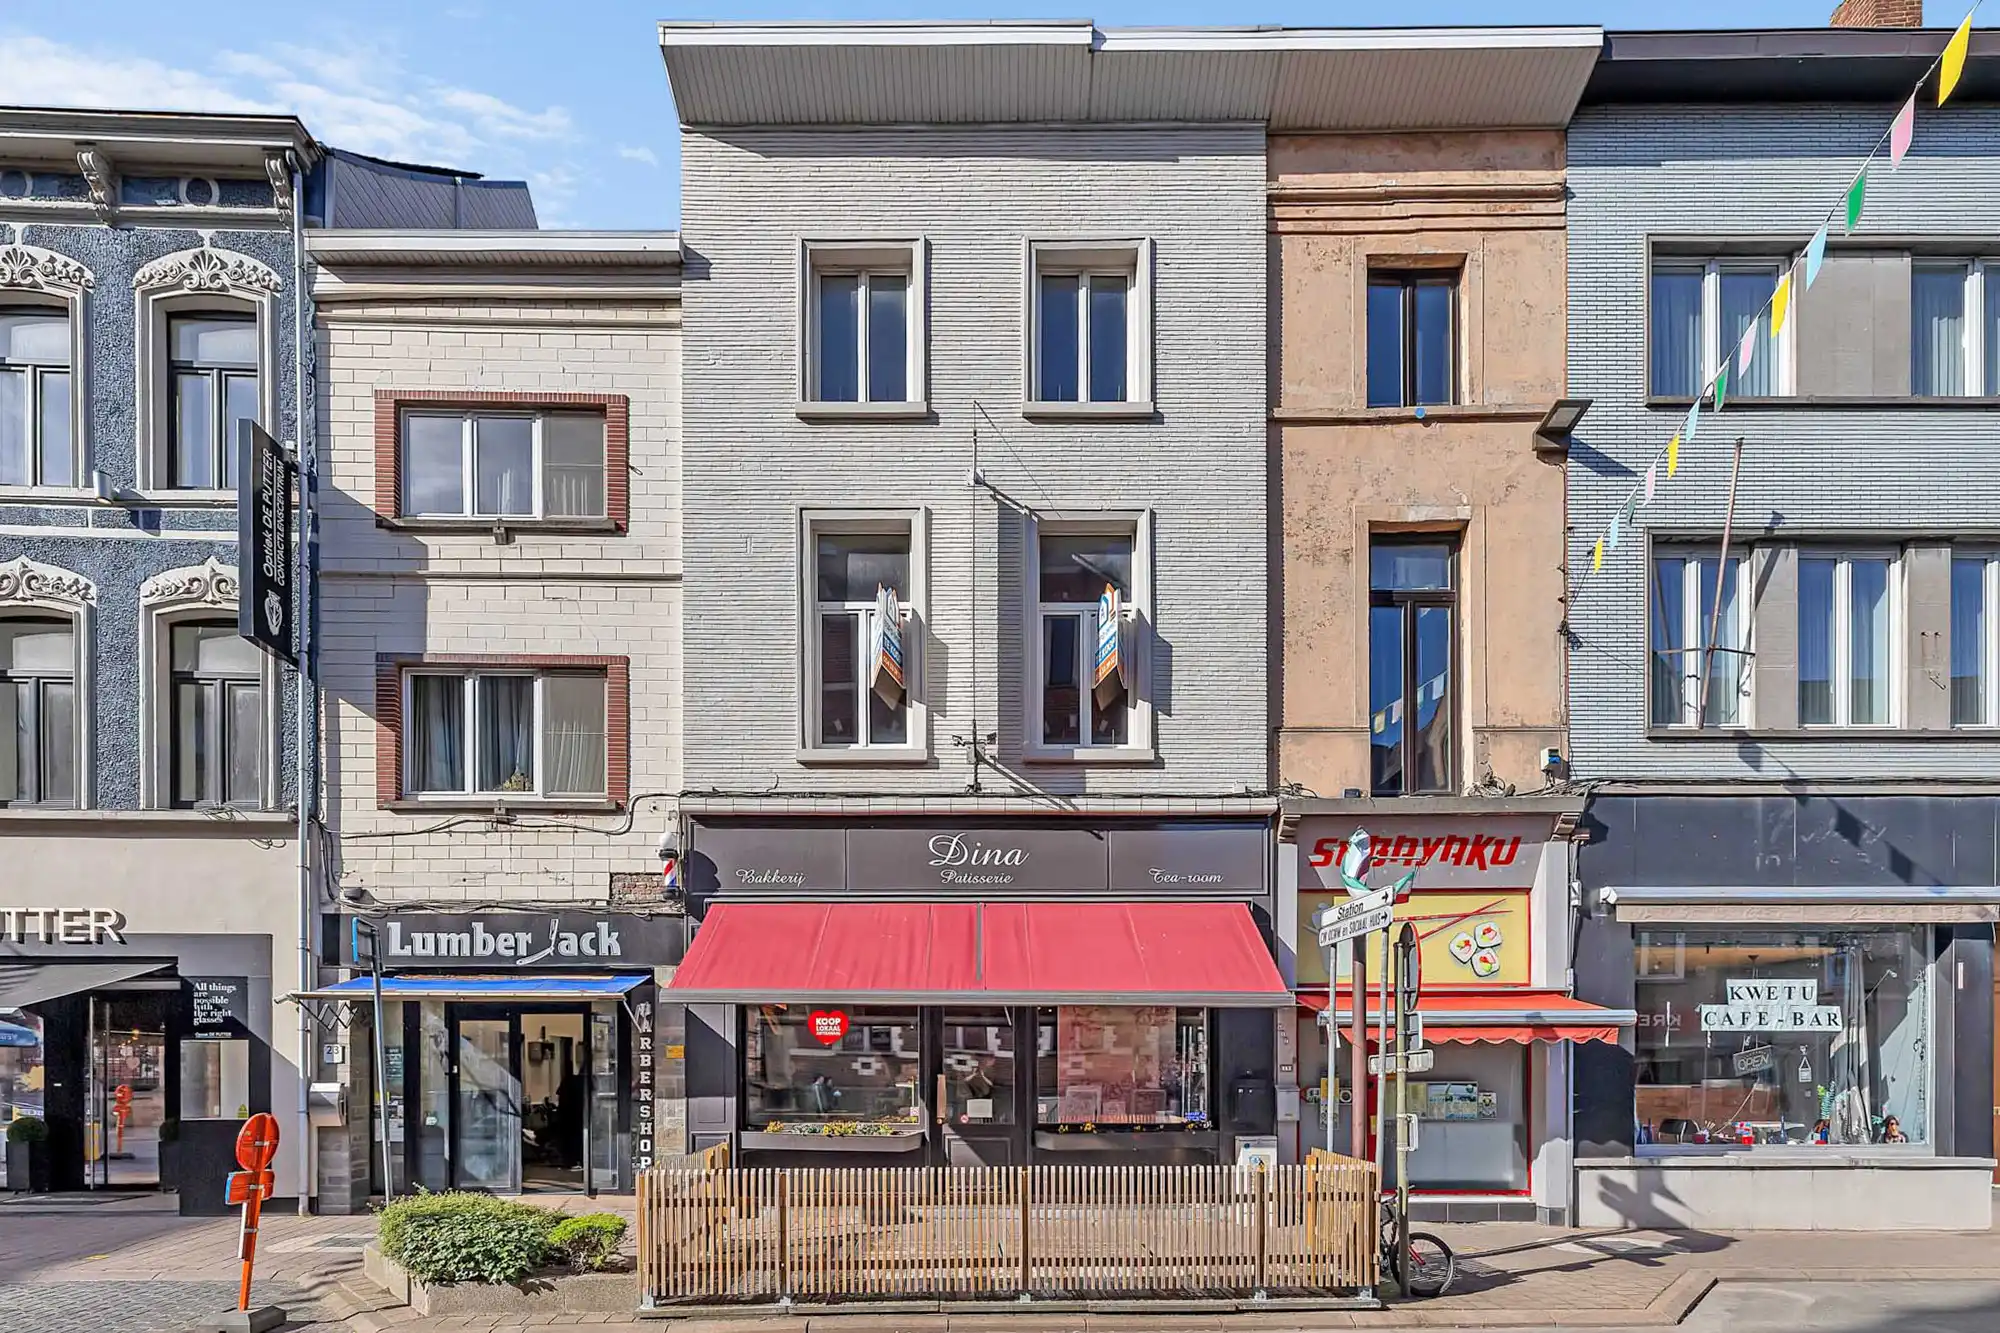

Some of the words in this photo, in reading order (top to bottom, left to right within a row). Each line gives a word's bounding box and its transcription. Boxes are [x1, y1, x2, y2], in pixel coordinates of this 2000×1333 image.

[262, 448, 273, 505] PUTTER
[262, 505, 273, 529] DE
[277, 459, 285, 587] CONTACTLENSCENTRUM
[262, 529, 274, 578] Optiek
[927, 832, 1030, 867] Dina
[1310, 835, 1521, 871] SBAYAKU
[735, 868, 806, 887] Bakkerij
[940, 869, 1013, 885] Patisserie
[1148, 867, 1224, 884] Tea-room
[1337, 902, 1364, 920] Station
[386, 921, 532, 957] Lumber
[516, 918, 621, 966] Jack
[193, 982, 208, 991] All
[209, 982, 236, 993] things
[1729, 986, 1814, 1001] KWETU
[193, 995, 229, 1010] possible
[210, 1008, 231, 1018] right
[815, 1017, 842, 1026] KOOP
[326, 1046, 340, 1054] 23
[1737, 1053, 1770, 1071] OPEN
